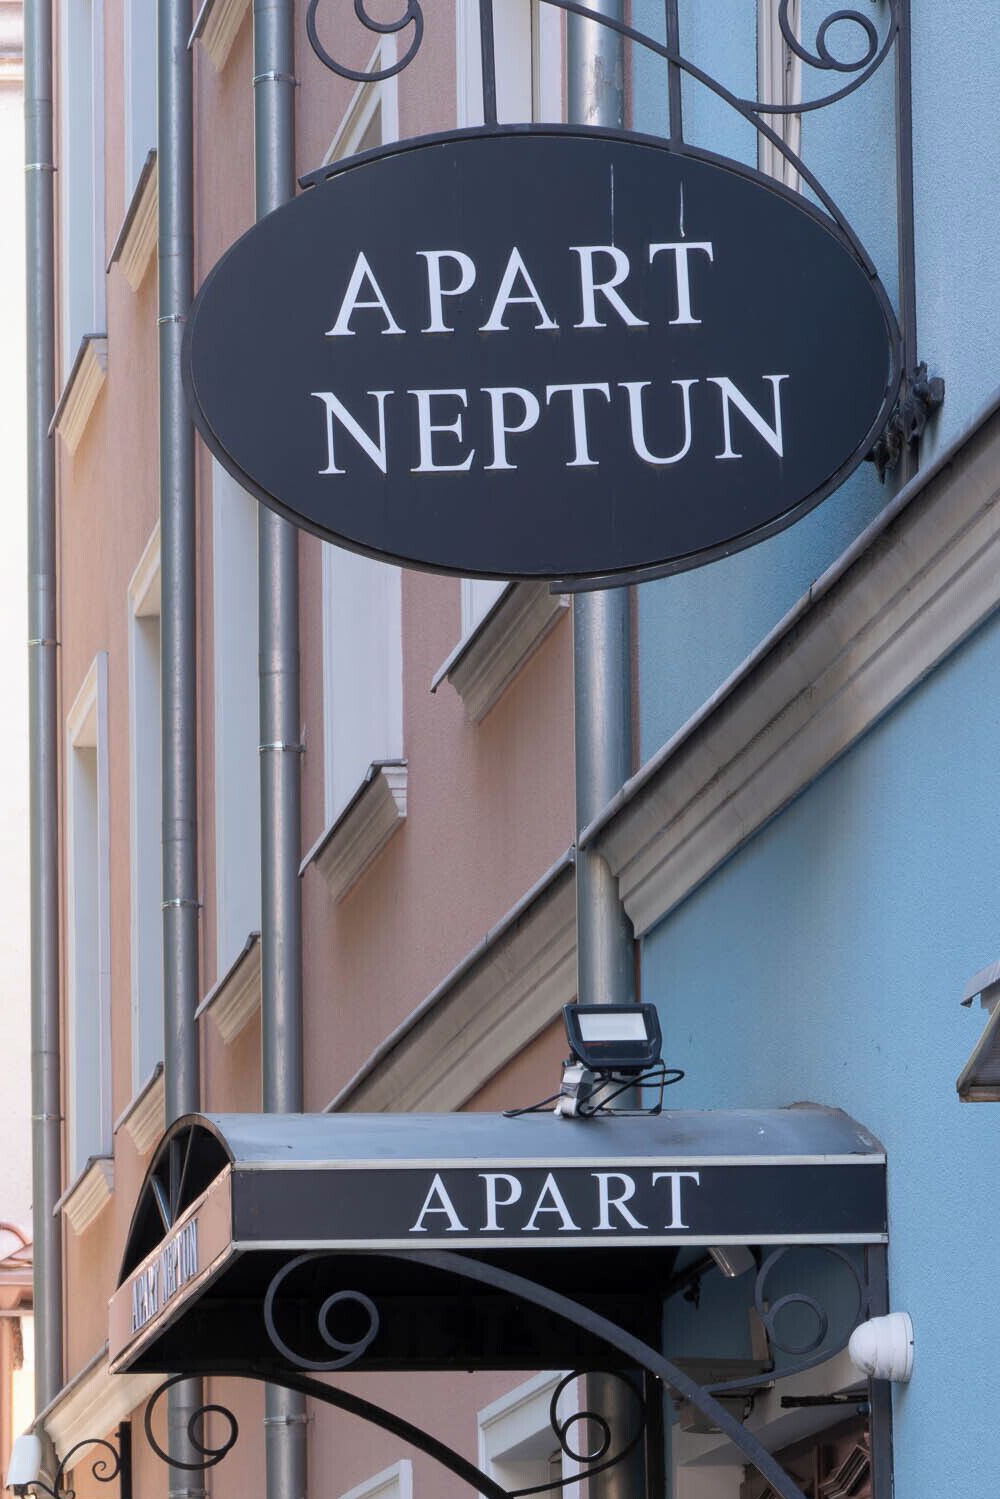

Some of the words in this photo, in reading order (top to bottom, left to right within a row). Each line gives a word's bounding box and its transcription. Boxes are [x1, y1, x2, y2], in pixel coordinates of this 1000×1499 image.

[325, 241, 715, 337] APART
[310, 374, 790, 476] NEPTUN
[409, 1171, 701, 1233] APART
